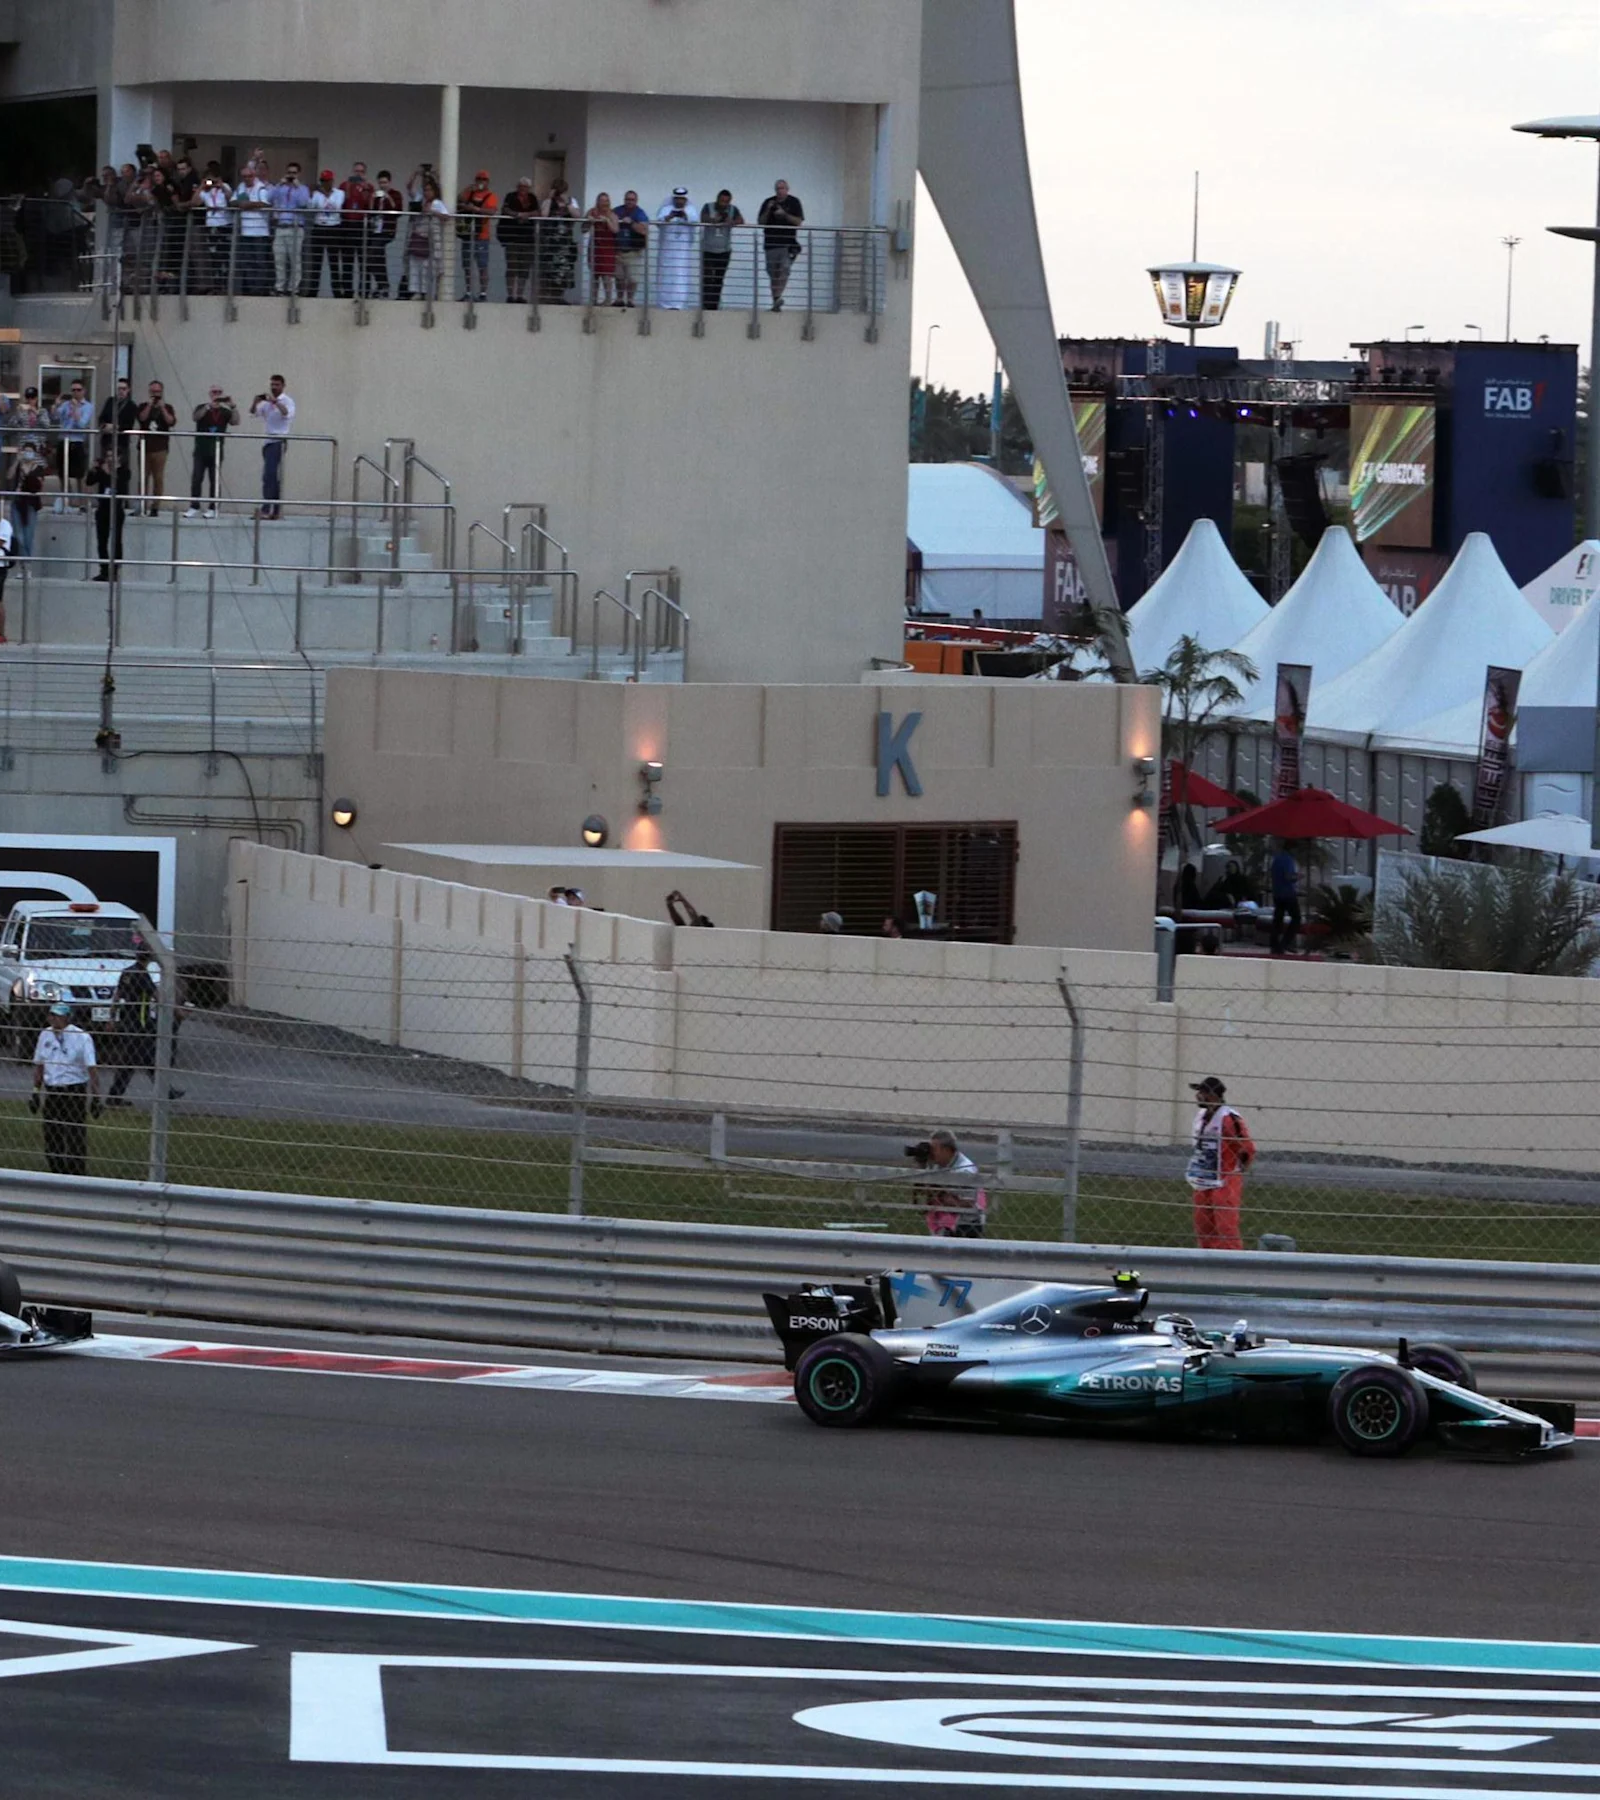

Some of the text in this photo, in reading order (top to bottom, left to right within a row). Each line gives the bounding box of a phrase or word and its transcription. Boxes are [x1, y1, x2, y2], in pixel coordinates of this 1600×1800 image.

[1484, 386, 1532, 412] FAB
[876, 712, 923, 797] K
[939, 1279, 972, 1308] 77
[789, 1315, 840, 1332] EPSON
[1078, 1373, 1183, 1393] PETRONAS
